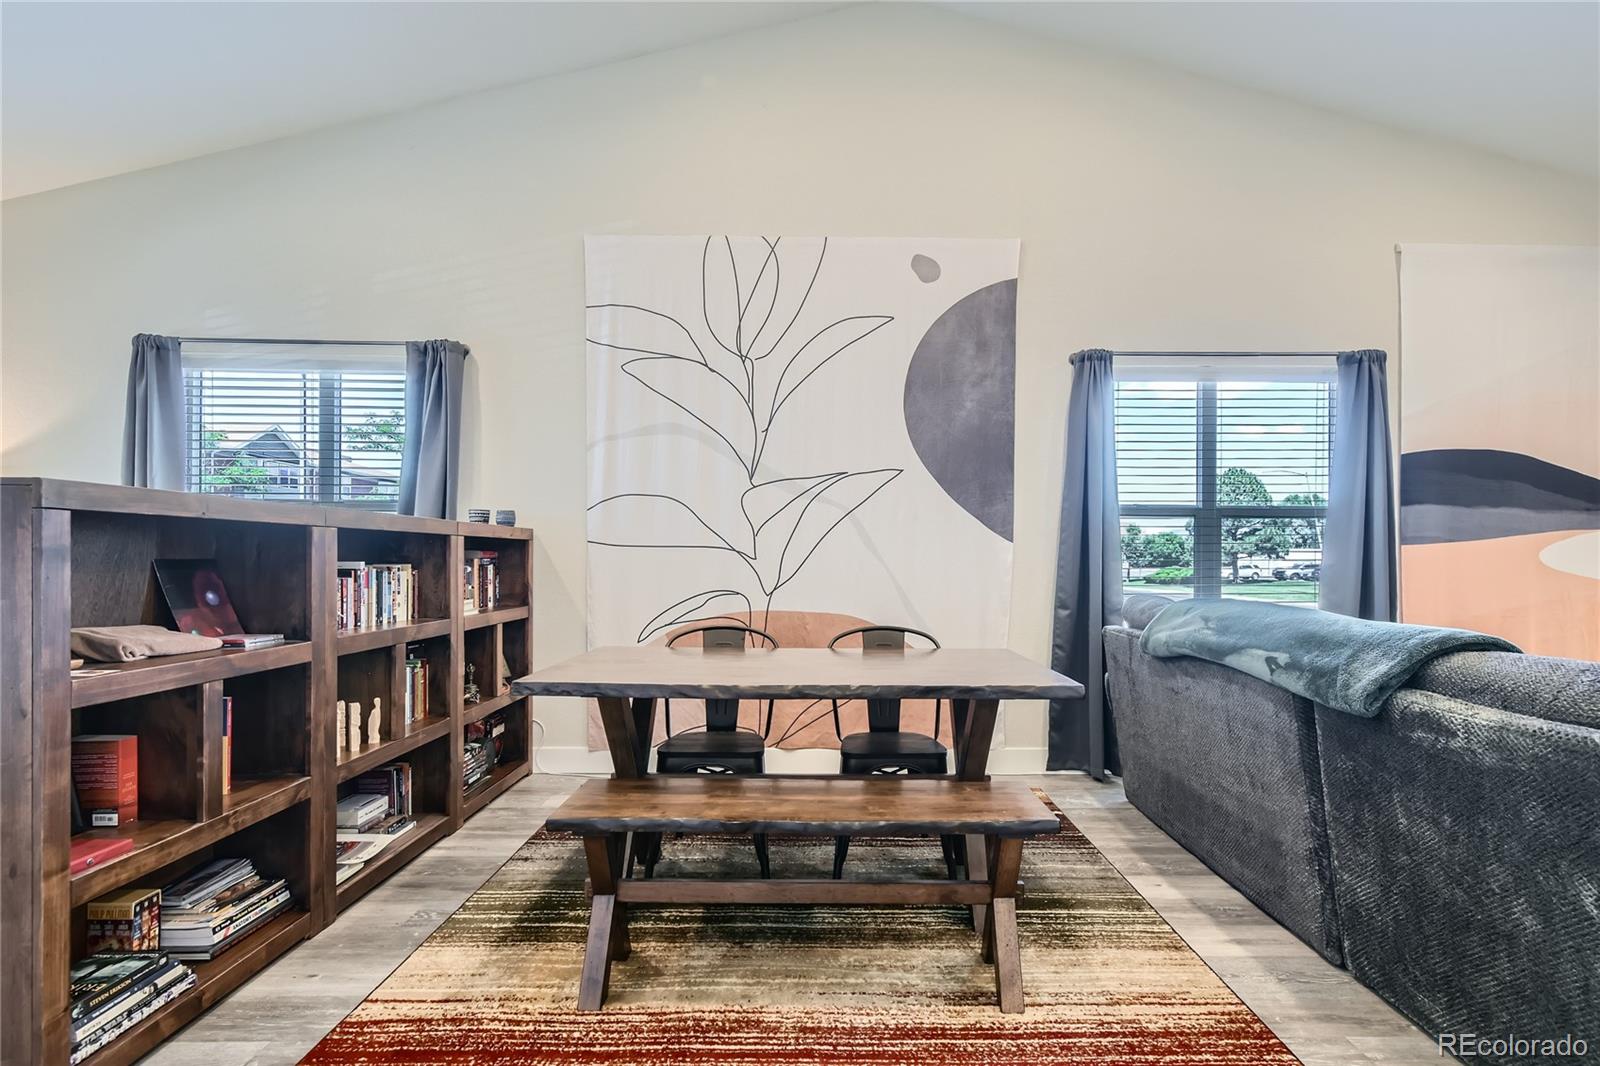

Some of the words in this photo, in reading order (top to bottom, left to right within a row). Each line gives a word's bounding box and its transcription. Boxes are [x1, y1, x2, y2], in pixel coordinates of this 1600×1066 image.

[89, 992, 109, 1007] STEVEN
[78, 1029, 105, 1050] STAR
[104, 1011, 129, 1031] WARS
